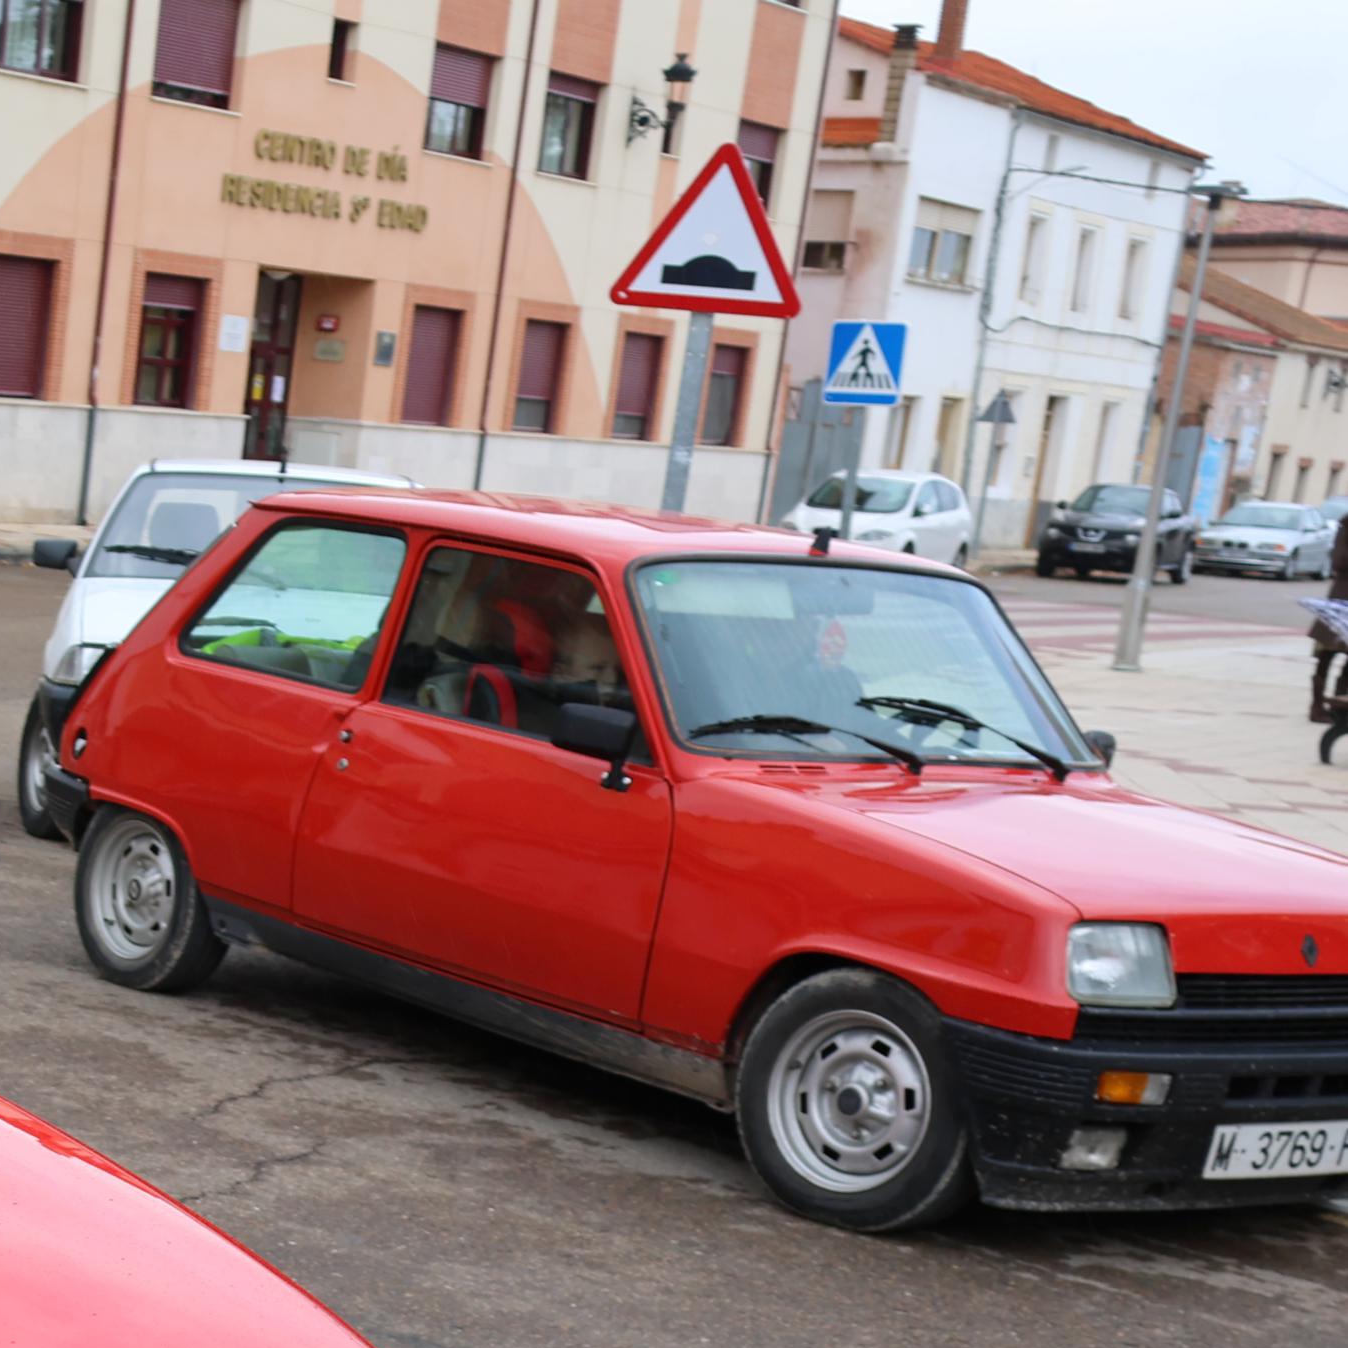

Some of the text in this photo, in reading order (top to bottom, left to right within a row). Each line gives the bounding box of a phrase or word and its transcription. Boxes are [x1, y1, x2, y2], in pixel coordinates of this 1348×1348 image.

[254, 129, 408, 182] CENTRO DE DÍA
[221, 173, 341, 219] RESIDENCIA
[376, 199, 428, 233] EDAD
